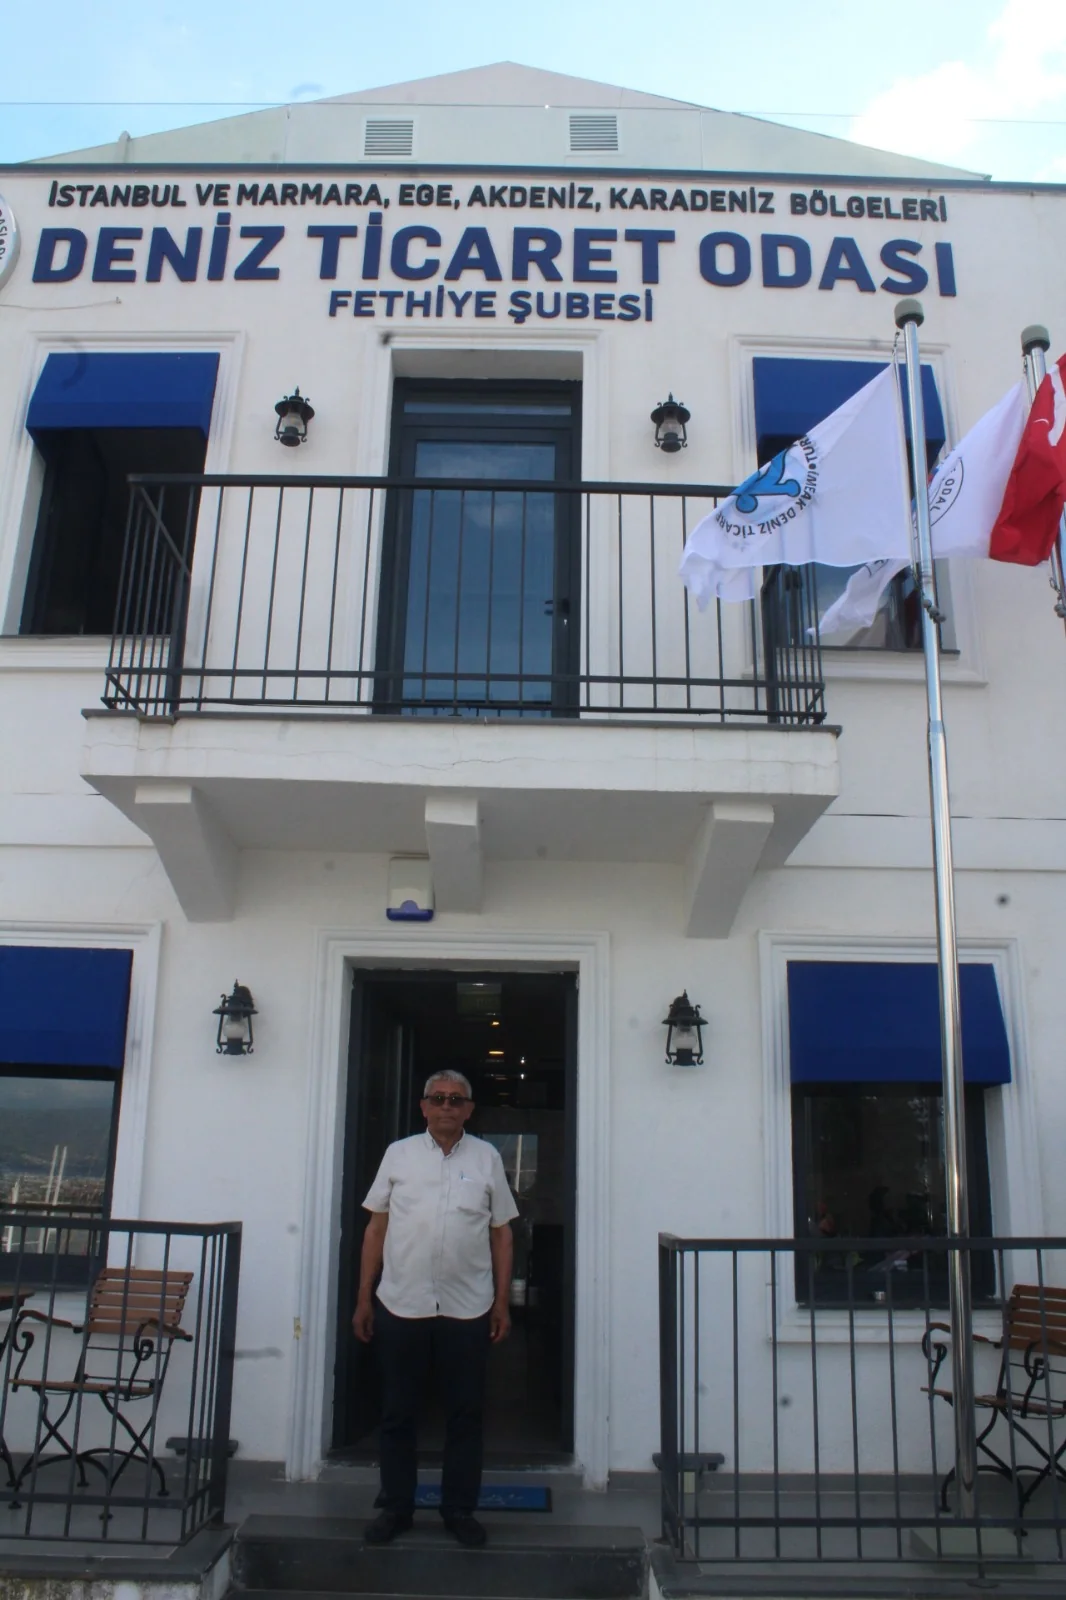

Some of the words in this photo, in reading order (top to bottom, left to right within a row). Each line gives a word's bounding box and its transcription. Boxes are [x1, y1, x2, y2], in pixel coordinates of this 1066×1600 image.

[47, 179, 187, 208] İSTANBUL
[195, 183, 231, 207] VE
[236, 182, 391, 210] MARMARA,
[398, 183, 461, 211] EGE,
[466, 181, 602, 213] AKDENİZ,
[609, 186, 775, 215] KARADENİZ
[789, 189, 948, 223] BÖLGELERİ
[32, 211, 286, 284] DENİZ
[306, 211, 676, 285] TİCARET
[698, 231, 957, 298] ODASI
[328, 284, 497, 319] FETHİYE
[507, 288, 653, 325] ŞUBESİ
[757, 507, 796, 535] DENİZ
